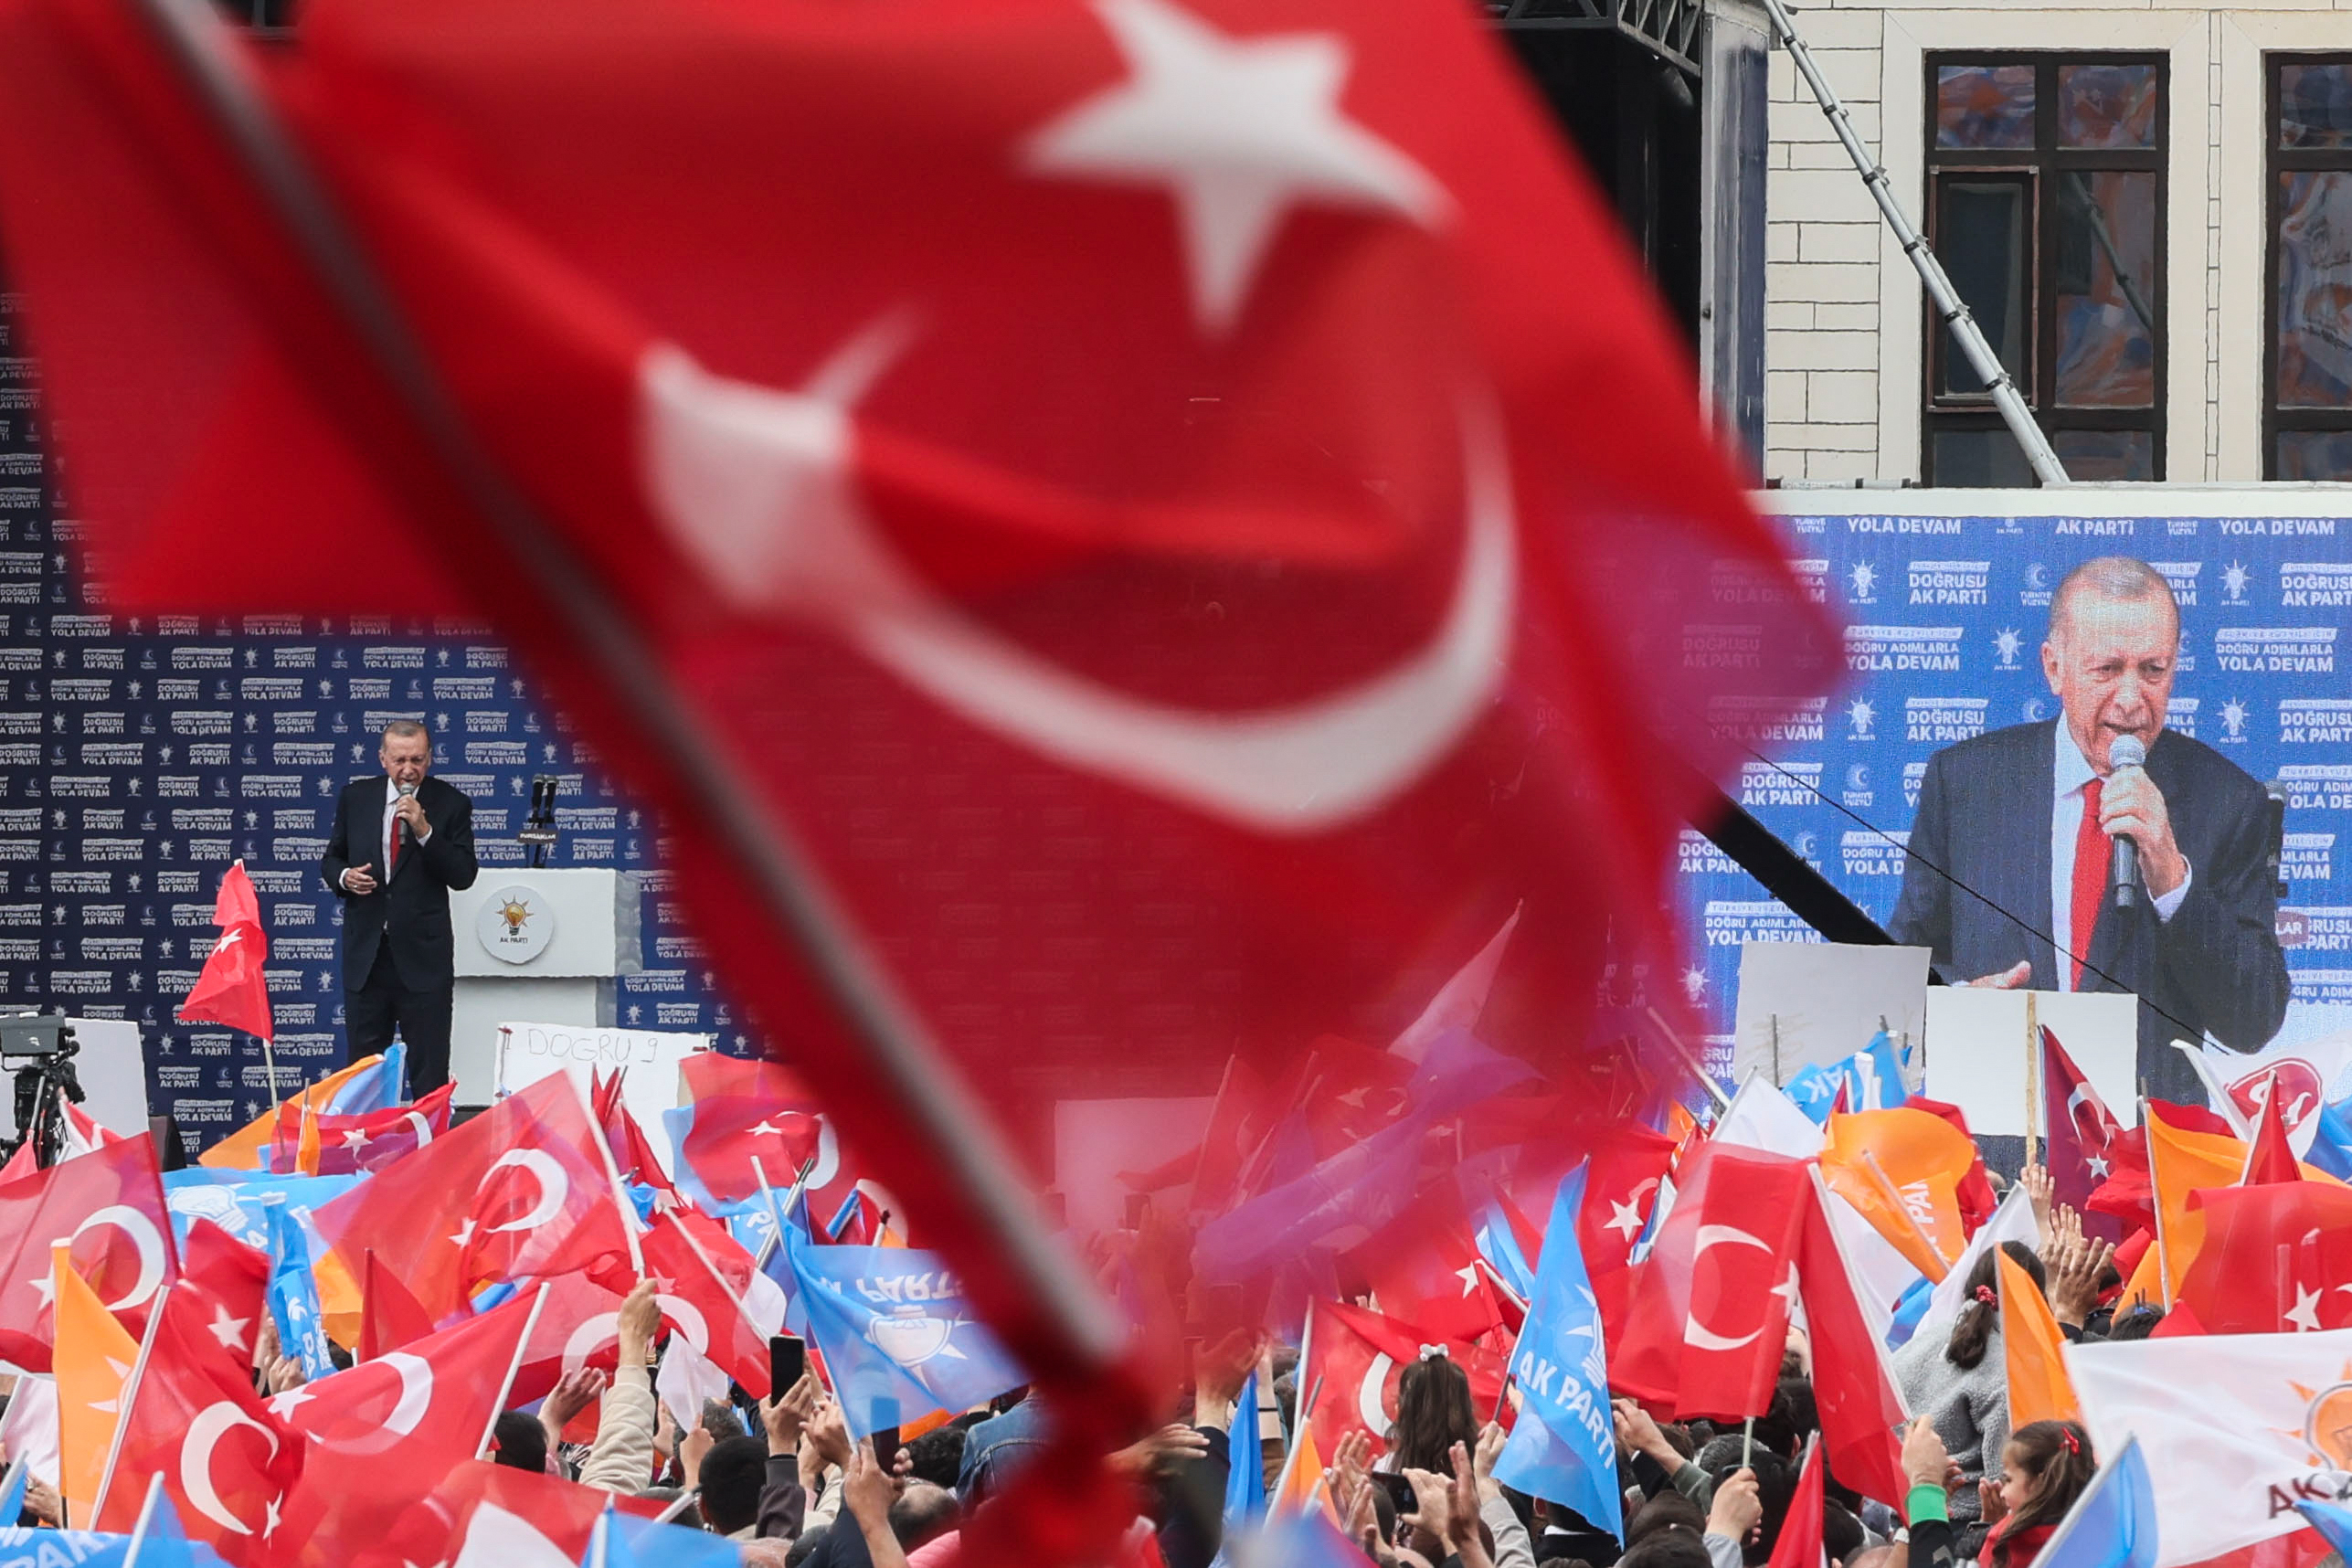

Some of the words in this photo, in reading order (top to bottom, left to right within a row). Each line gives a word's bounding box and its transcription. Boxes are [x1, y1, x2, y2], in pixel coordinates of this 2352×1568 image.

[1848, 518, 1894, 533] YOLA
[1899, 519, 1961, 534] DEVAM
[2056, 519, 2081, 535] AK
[2219, 520, 2266, 535] YOLA
[2271, 520, 2335, 535] DEVAM
[1909, 589, 1934, 605] AK
[2282, 591, 2307, 606] AK
[2311, 591, 2352, 606] PART
[1890, 642, 1959, 653] ADIMLARLA
[2262, 643, 2333, 655] ADIMLARLA
[1846, 655, 1893, 670] YOLA
[1896, 655, 1959, 671] DEVAM
[2218, 656, 2265, 671] YOLA
[2269, 656, 2333, 672] DEVAM
[1908, 726, 1933, 741] AK
[2281, 728, 2305, 742] AK
[2309, 728, 2352, 743] PART
[2286, 781, 2319, 792] OĞRU
[1742, 790, 1767, 805] AK
[2290, 795, 2326, 809] OLA
[2281, 851, 2329, 863] MLARLA
[1679, 859, 1703, 873] AK
[1844, 861, 1890, 875] YOLA
[2278, 864, 2329, 879] EVAM
[1706, 929, 1753, 946] YOLA
[1758, 929, 1822, 943] DEVAM
[2305, 935, 2347, 950] PART
[1520, 1351, 1557, 1397] AK
[2268, 1477, 2332, 1520] AK
